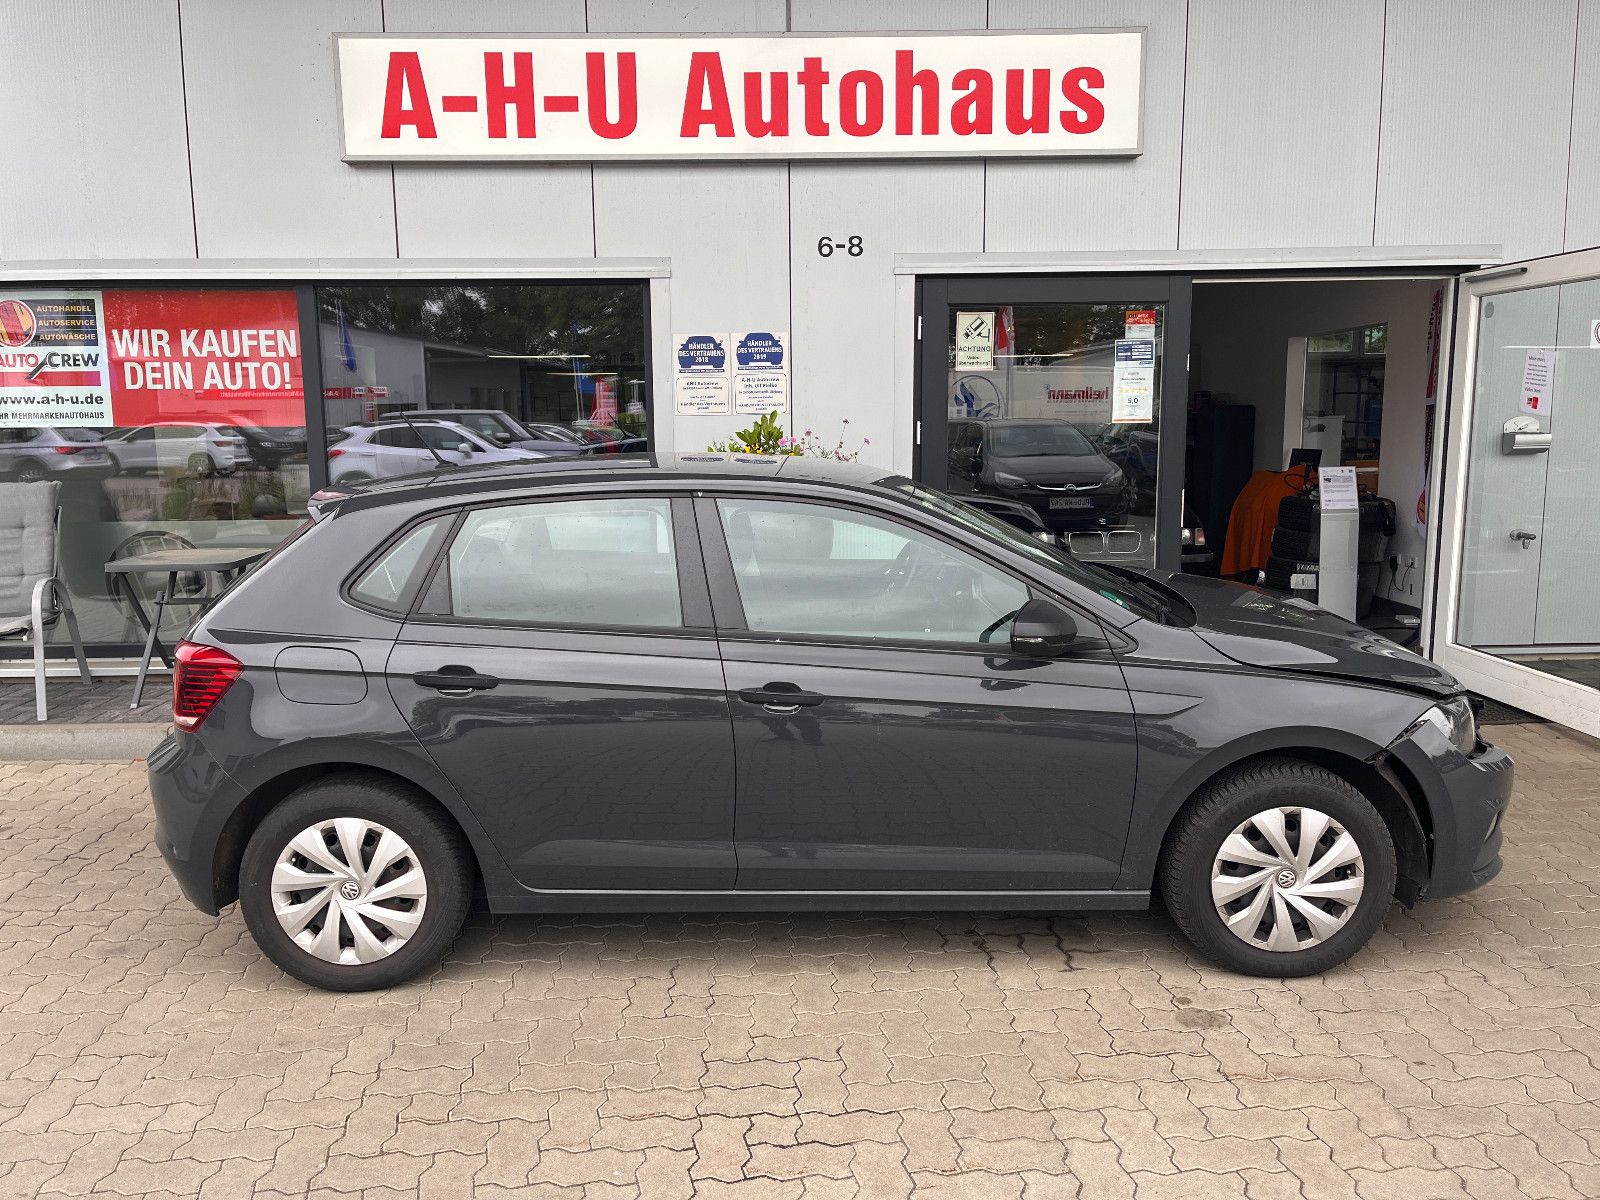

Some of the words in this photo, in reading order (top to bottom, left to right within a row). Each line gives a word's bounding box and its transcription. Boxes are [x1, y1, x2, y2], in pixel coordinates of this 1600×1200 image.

[380, 51, 638, 140] A-H-U
[680, 49, 1105, 139] Autohaus
[817, 236, 864, 258] 6-8
[38, 319, 95, 327] AUTOSERVICE
[39, 332, 97, 341] AUTOWÄSCHE
[111, 328, 172, 358] WIR
[180, 328, 298, 358] KAUFEN
[747, 339, 772, 347] HÄNDLER
[47, 352, 100, 368] CREW
[123, 361, 194, 390] DEIN
[202, 361, 292, 391] AUTO!
[0, 394, 104, 406] www.a-h-u.de
[1126, 397, 1139, 405] 5,0
[11, 411, 105, 420] MEHRMARKENAUTOHAUS
